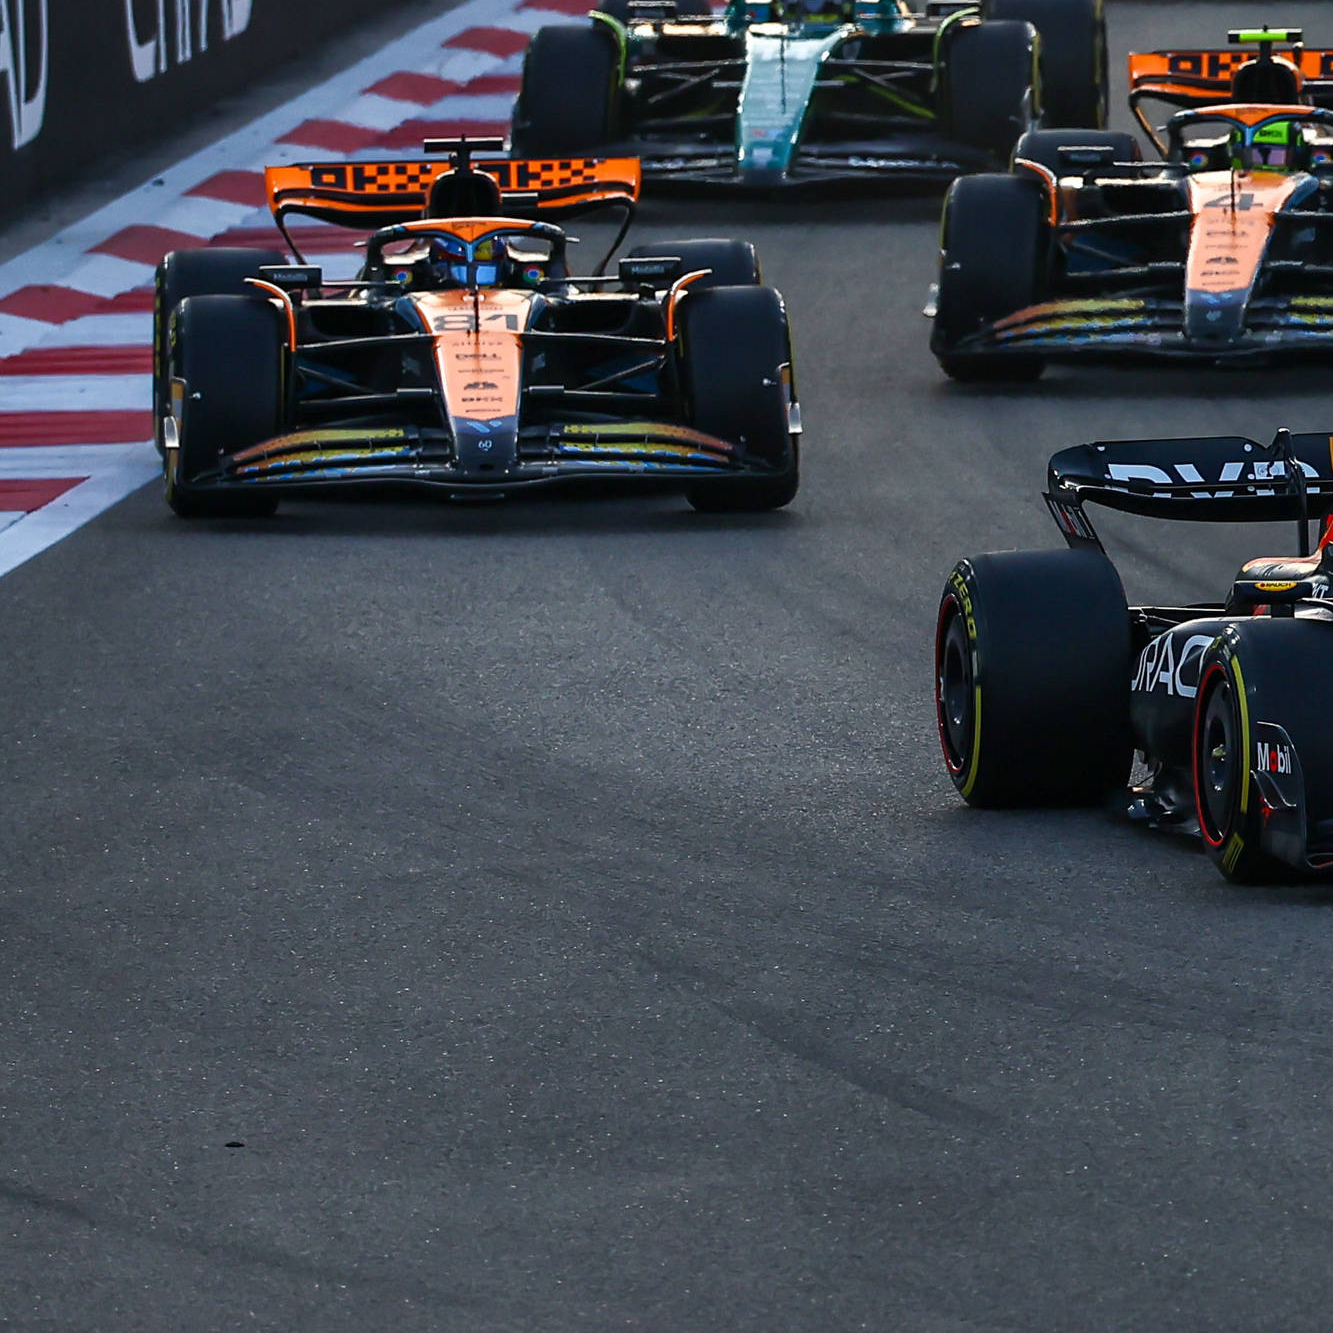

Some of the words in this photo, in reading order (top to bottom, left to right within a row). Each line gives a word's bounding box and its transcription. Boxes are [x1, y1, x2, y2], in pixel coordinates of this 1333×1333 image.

[1203, 194, 1264, 211] 4
[433, 314, 518, 331] 81
[1257, 741, 1292, 775] Mobil
